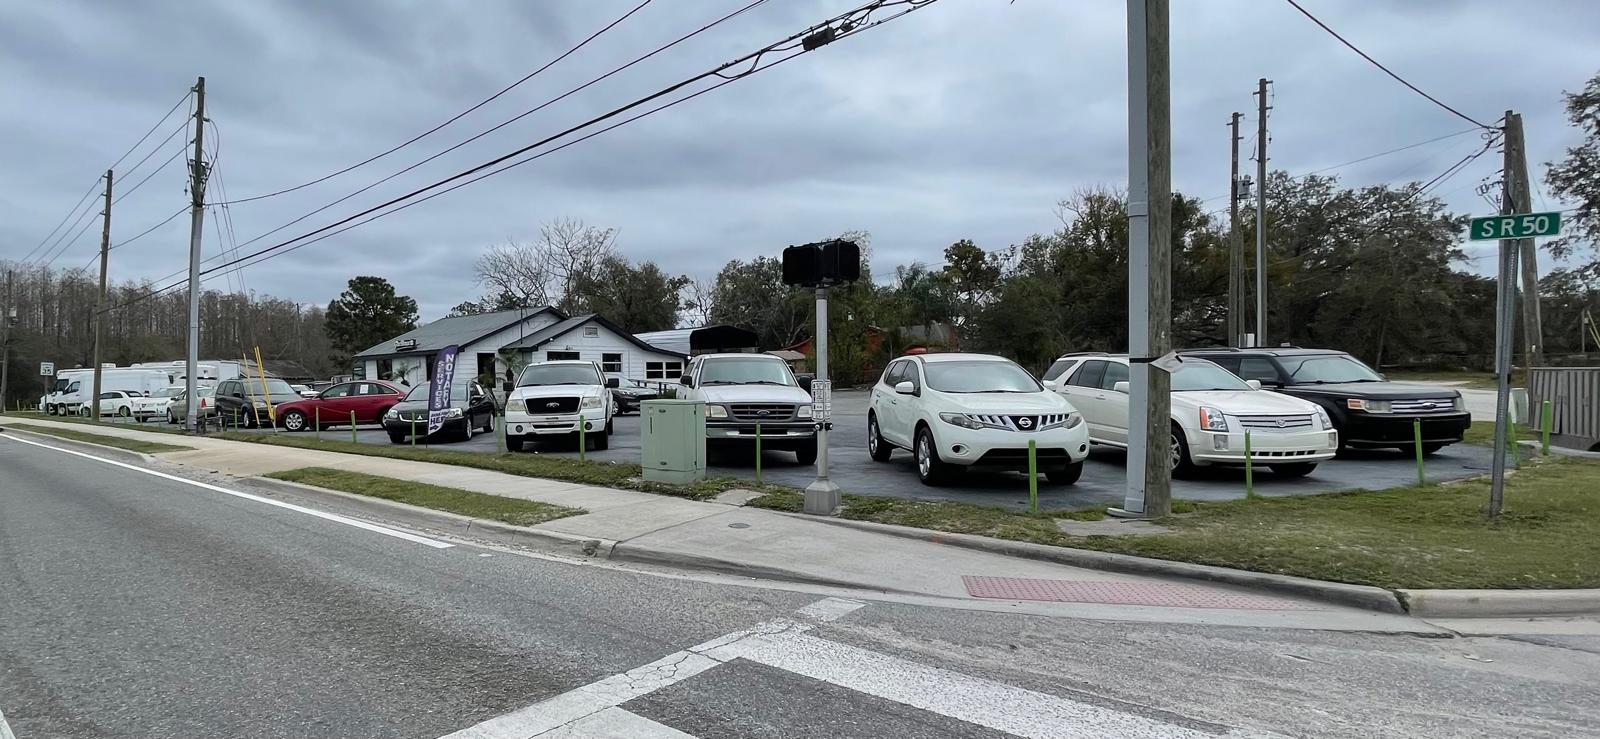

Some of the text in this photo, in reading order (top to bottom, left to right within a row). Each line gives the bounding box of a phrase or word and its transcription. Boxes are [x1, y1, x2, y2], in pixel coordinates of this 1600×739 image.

[1522, 215, 1549, 235] 50
[435, 361, 445, 408] SERVICES
[443, 354, 454, 407] NOTARY
